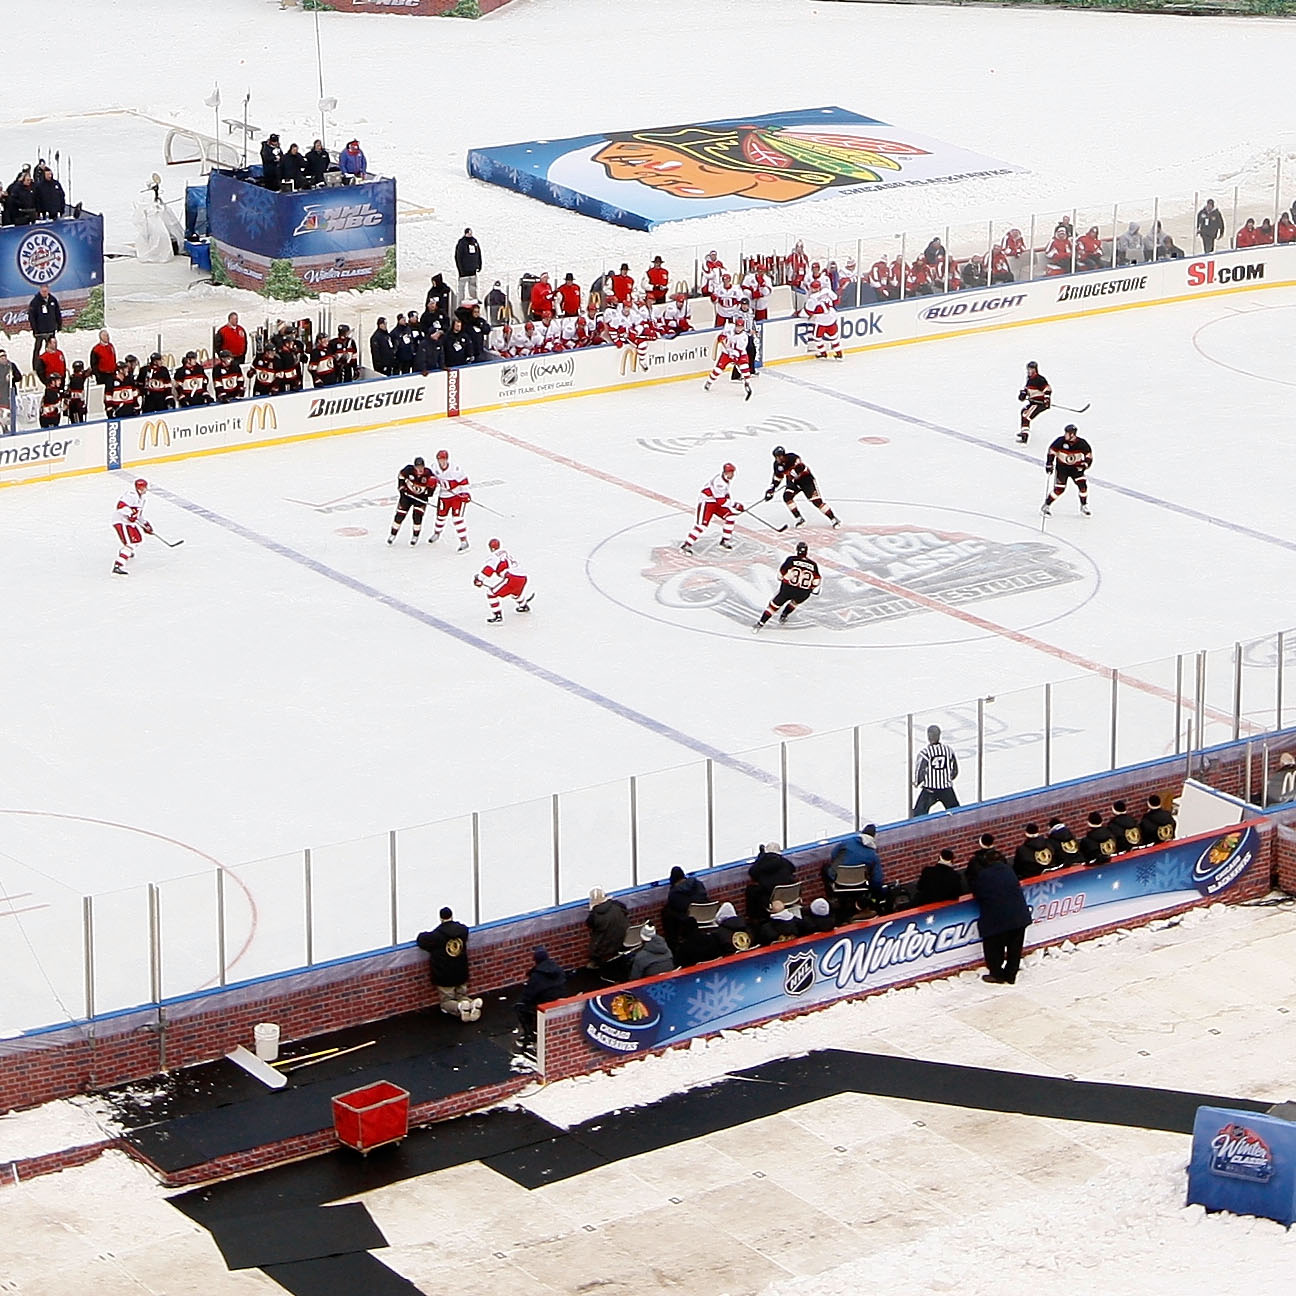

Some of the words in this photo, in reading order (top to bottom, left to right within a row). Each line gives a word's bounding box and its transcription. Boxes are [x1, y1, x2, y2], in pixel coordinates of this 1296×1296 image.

[324, 204, 378, 218] NHL
[326, 214, 384, 232] NBC
[22, 234, 62, 259] HOCKEY
[26, 262, 62, 282] NIGHT
[304, 268, 340, 285] Winter
[340, 266, 374, 279] CLASSIC
[1186, 261, 1266, 287] SI.COM
[1057, 276, 1148, 304] BRIDGESTONE
[926, 302, 967, 322] BUD
[972, 294, 1028, 313] LIGHT
[648, 354, 665, 366] i'm
[668, 346, 698, 362] lovin'
[699, 346, 709, 357] it
[308, 386, 426, 418] BRIDGESTONE
[448, 370, 458, 412] Reebok
[172, 427, 192, 440] i'm
[195, 418, 230, 436] lovin'
[232, 418, 242, 430] it
[108, 422, 118, 465] Reebok
[790, 568, 812, 588] 32
[1034, 892, 1087, 926] 2009
[820, 919, 941, 989] Winter
[790, 962, 811, 990] NHL
[1211, 1134, 1268, 1160] Winter
